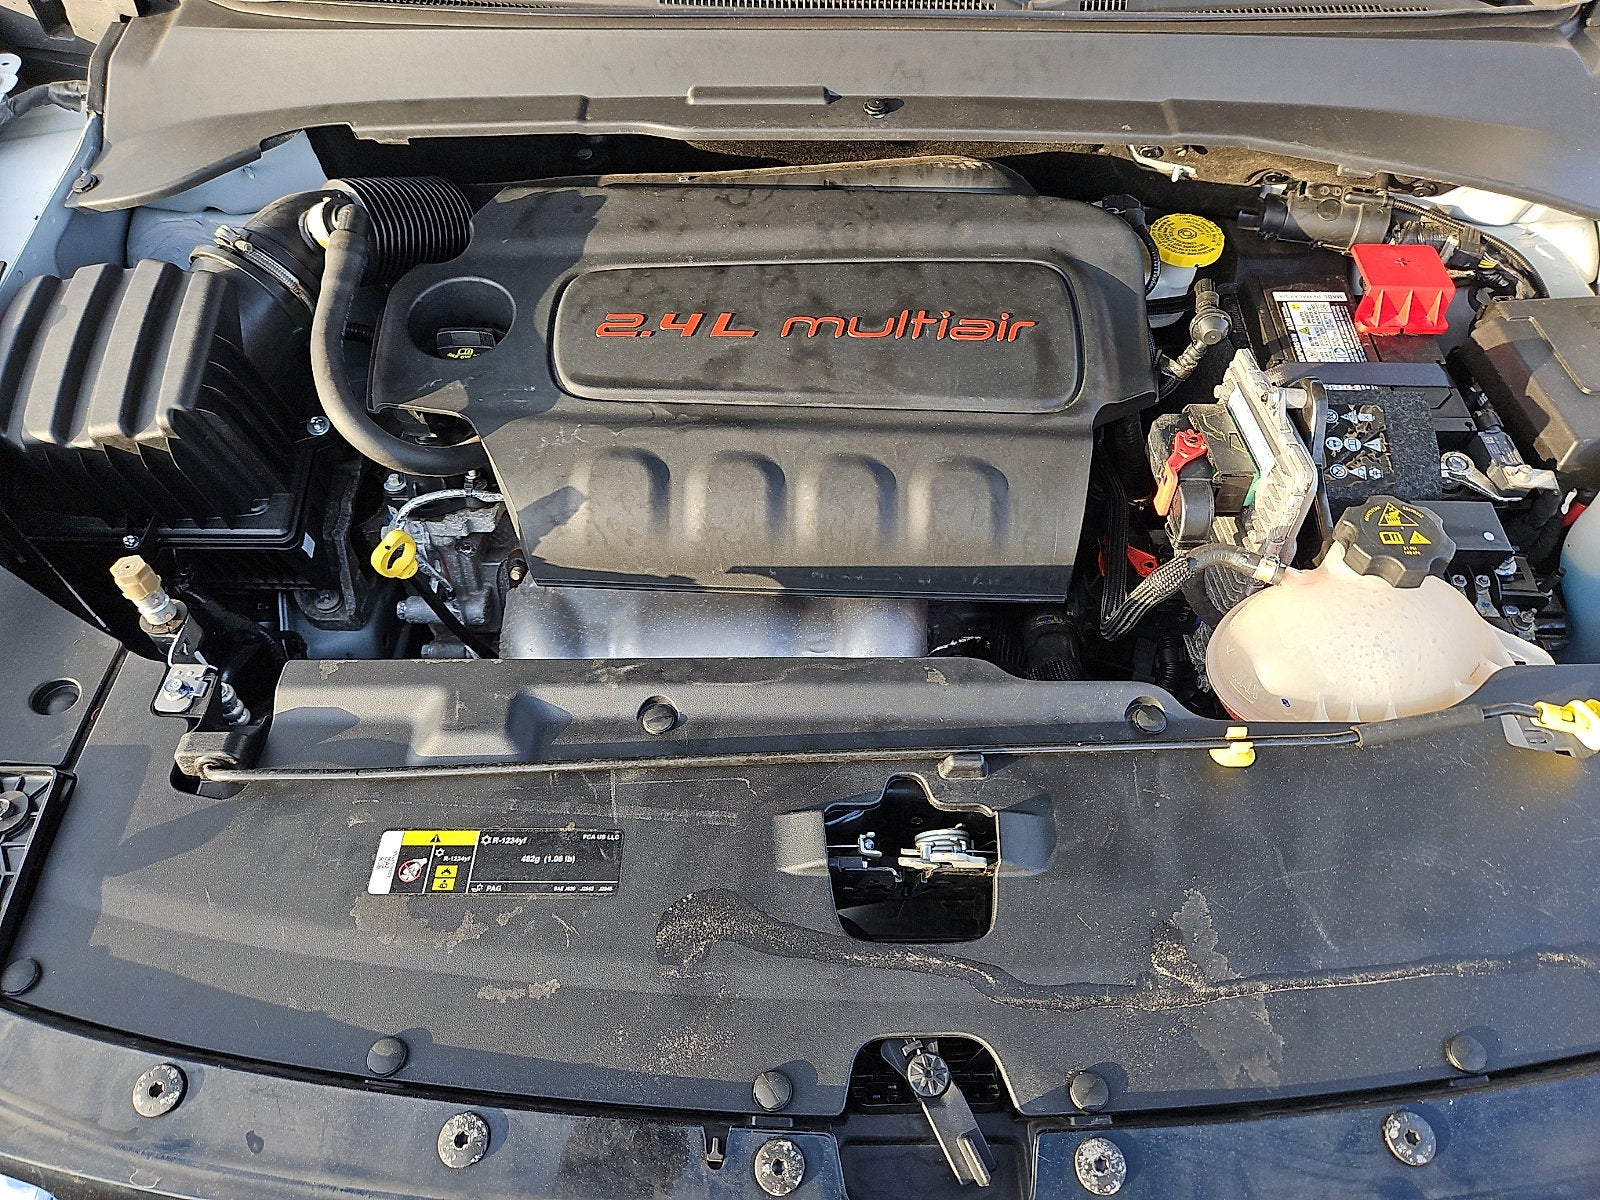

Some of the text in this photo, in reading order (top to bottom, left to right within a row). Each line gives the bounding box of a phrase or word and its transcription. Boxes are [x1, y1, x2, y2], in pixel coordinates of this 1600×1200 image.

[781, 308, 1036, 341] multiair
[492, 836, 527, 845] R-1234yf
[564, 855, 576, 864] lb)
